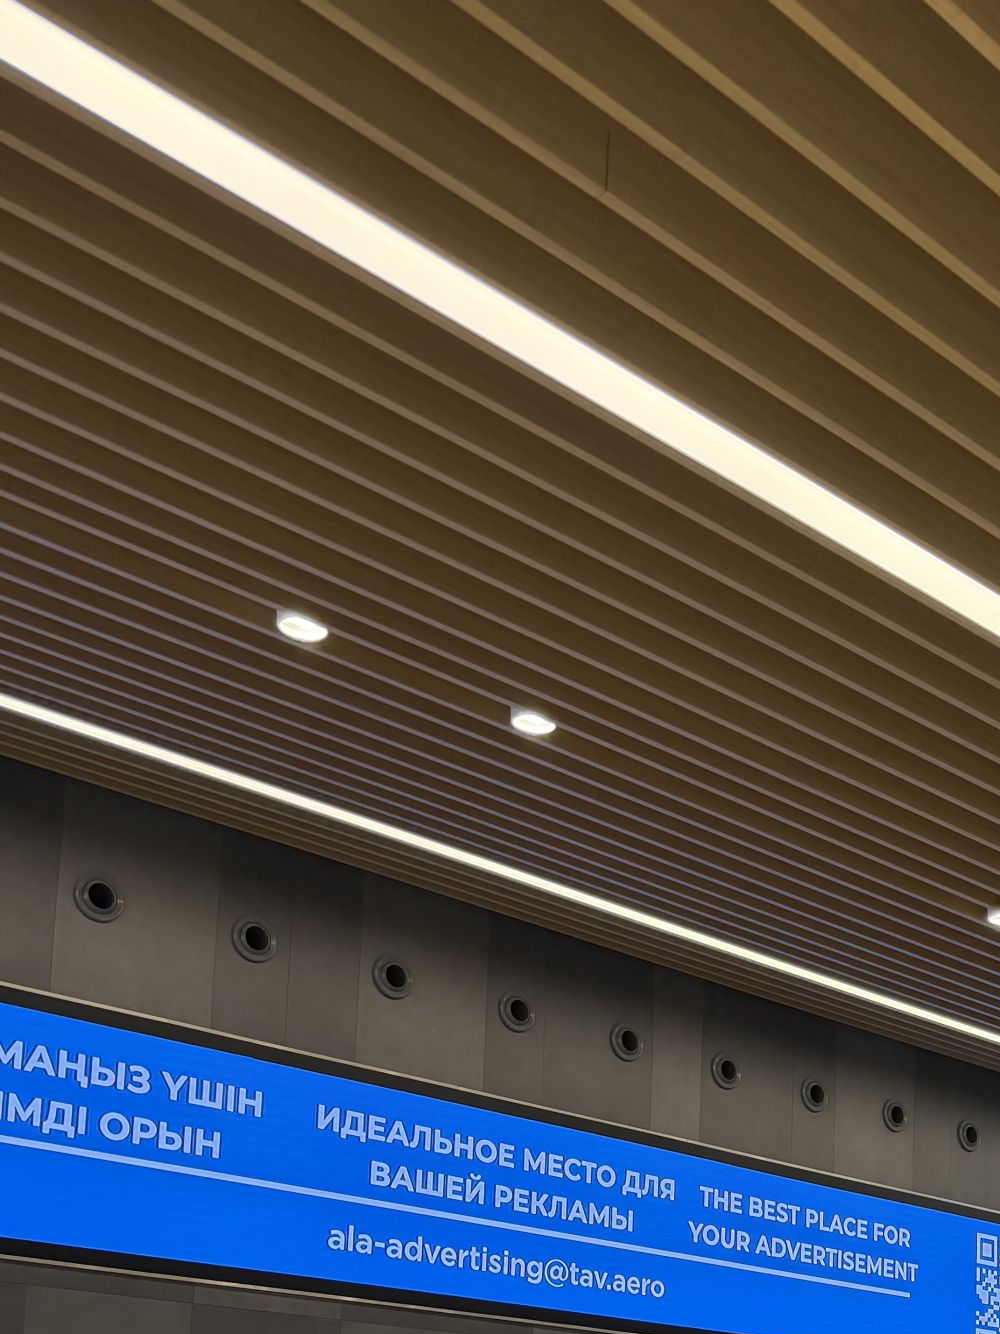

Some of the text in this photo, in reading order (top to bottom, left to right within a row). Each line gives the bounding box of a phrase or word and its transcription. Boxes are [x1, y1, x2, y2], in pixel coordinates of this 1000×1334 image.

[162, 1071, 262, 1117] ҮШІН
[100, 1112, 220, 1159] ОРЫН
[318, 1104, 675, 1200] ИДЕАЛЬНОЕ МЕСТО ДЛЯ
[370, 1160, 633, 1232] ВАШЕЙ РЕКЛАМЫ
[700, 1186, 910, 1248] THE BEST PLACE FOR
[328, 1225, 665, 1297] ala-advertising@tav.aero
[688, 1221, 918, 1282] YOUR ADVERTISEMENT
